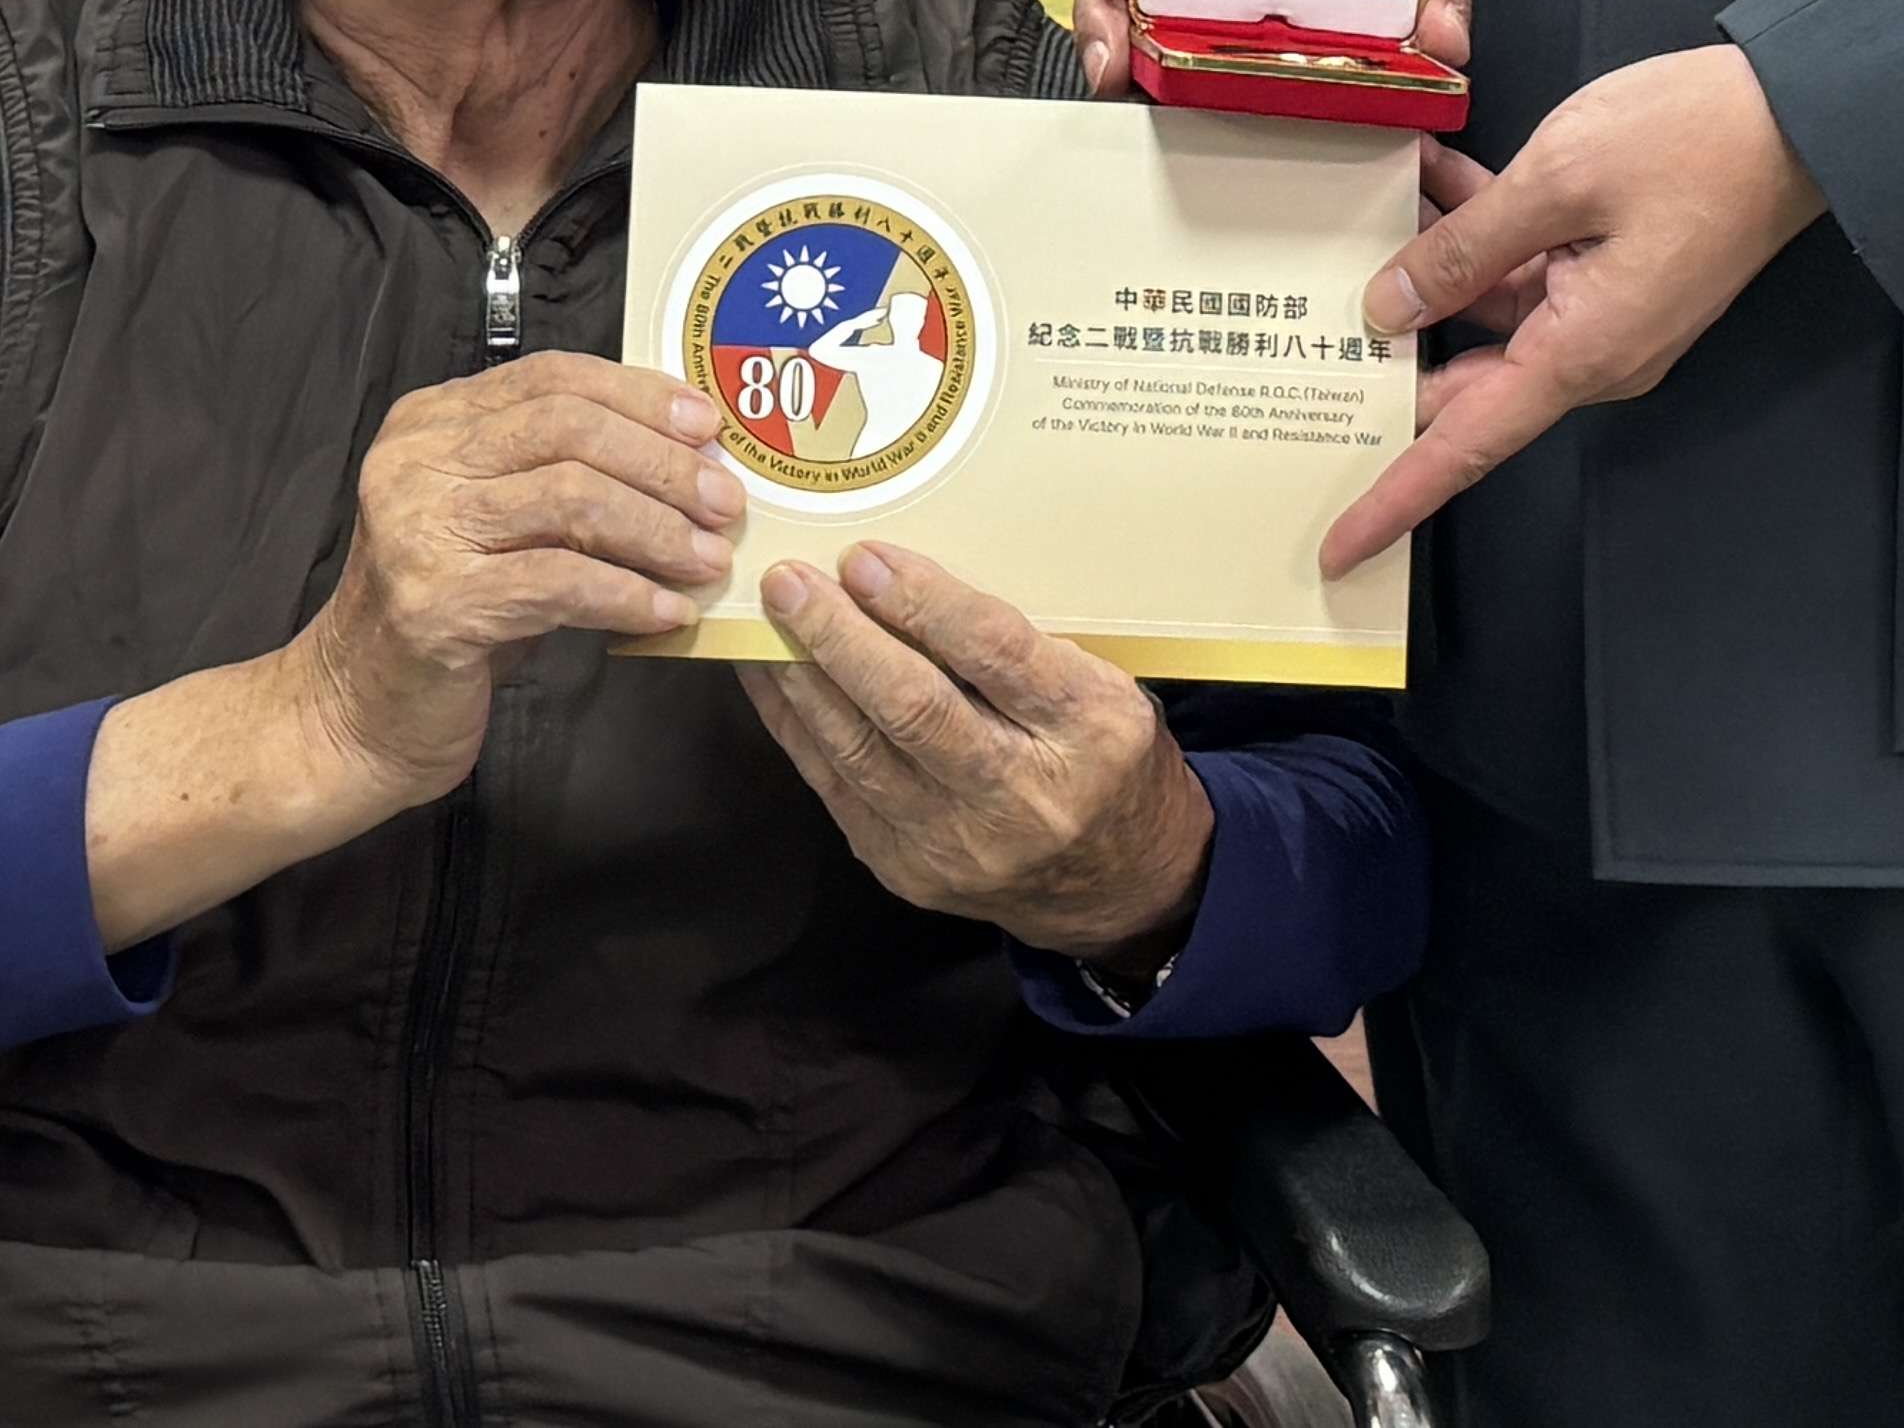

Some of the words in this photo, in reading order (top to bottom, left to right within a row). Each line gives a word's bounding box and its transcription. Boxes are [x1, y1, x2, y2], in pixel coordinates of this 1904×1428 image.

[1114, 286, 1309, 321] 中華民國國防部
[1027, 321, 1393, 363] 紀念二戰暨抗戰勝利八十週年
[737, 354, 815, 423] 80
[1114, 378, 1129, 392] of
[1185, 402, 1200, 417] of
[1204, 404, 1227, 418] the
[1032, 416, 1047, 430] of
[1050, 417, 1074, 431] the
